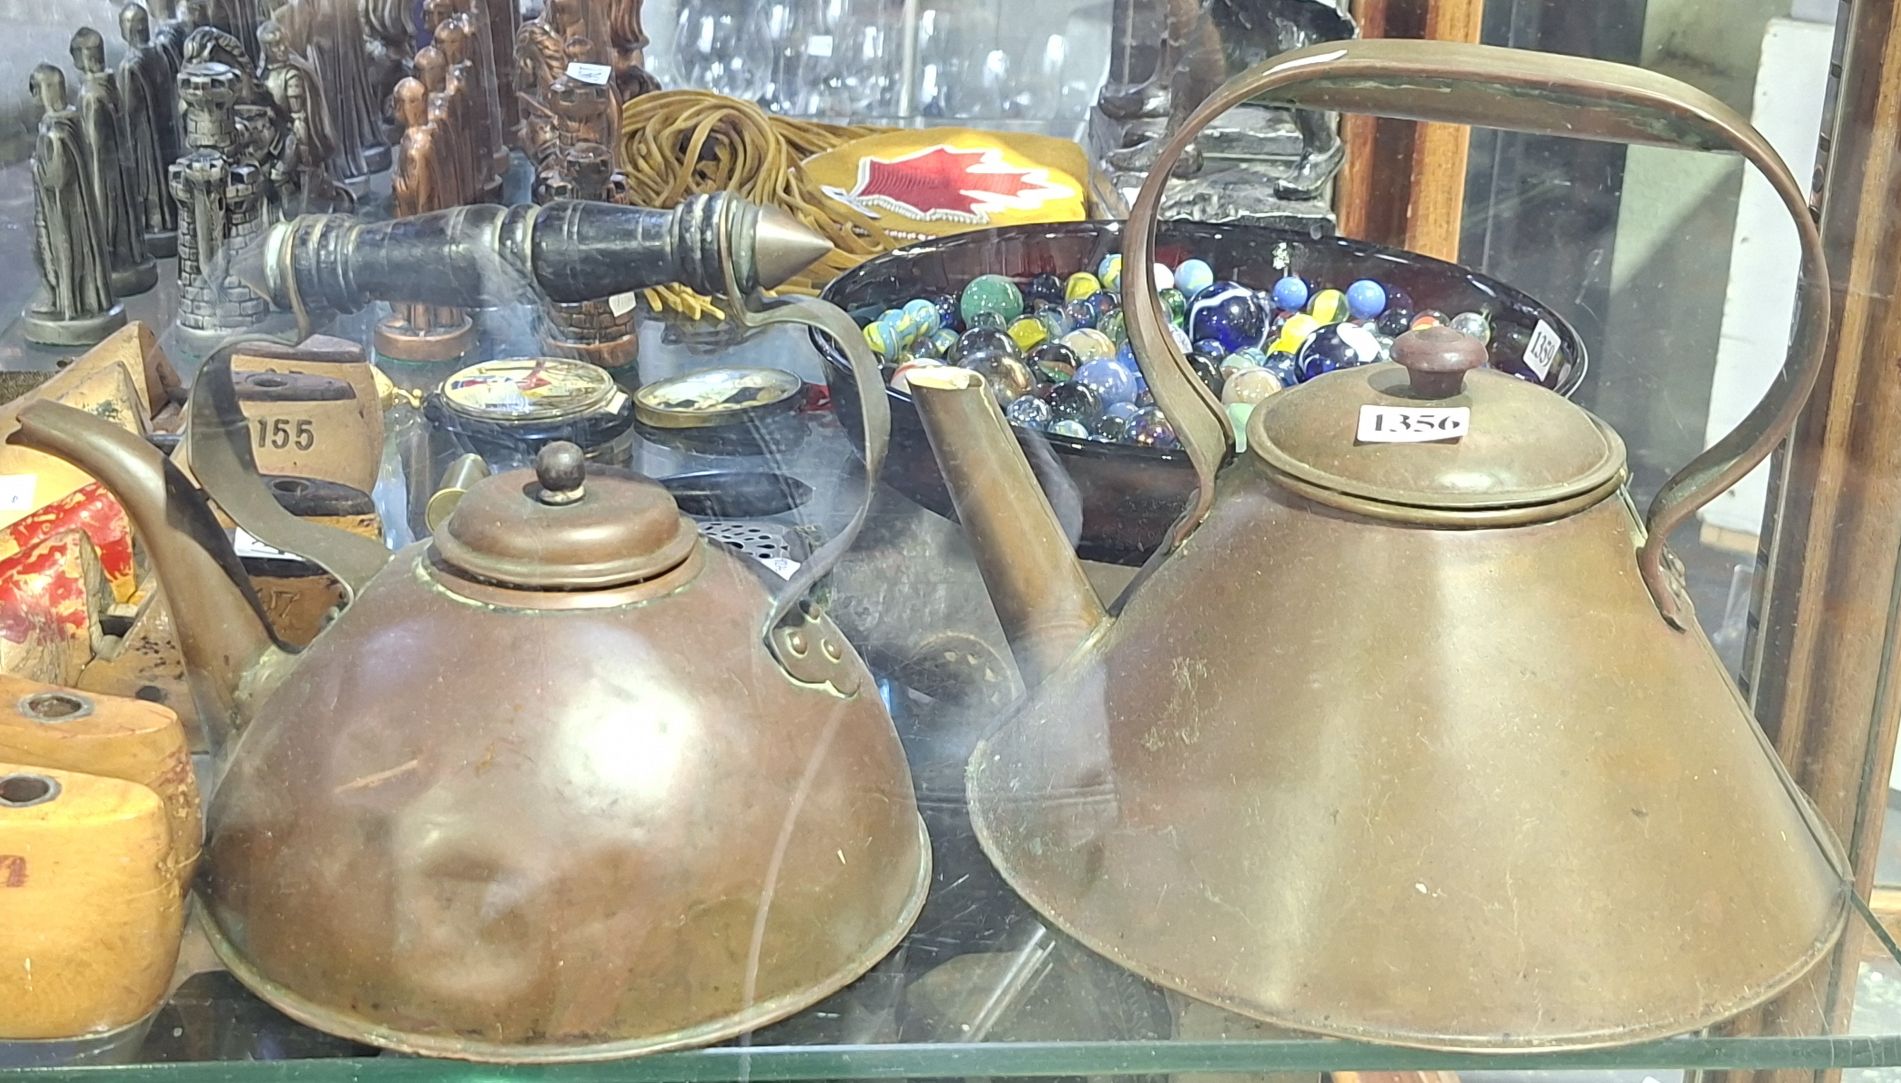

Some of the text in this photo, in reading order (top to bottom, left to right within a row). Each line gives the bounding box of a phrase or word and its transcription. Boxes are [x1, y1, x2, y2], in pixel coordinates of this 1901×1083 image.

[1530, 331, 1555, 368] 1359
[257, 418, 315, 451] 155
[1374, 413, 1461, 433] 1356
